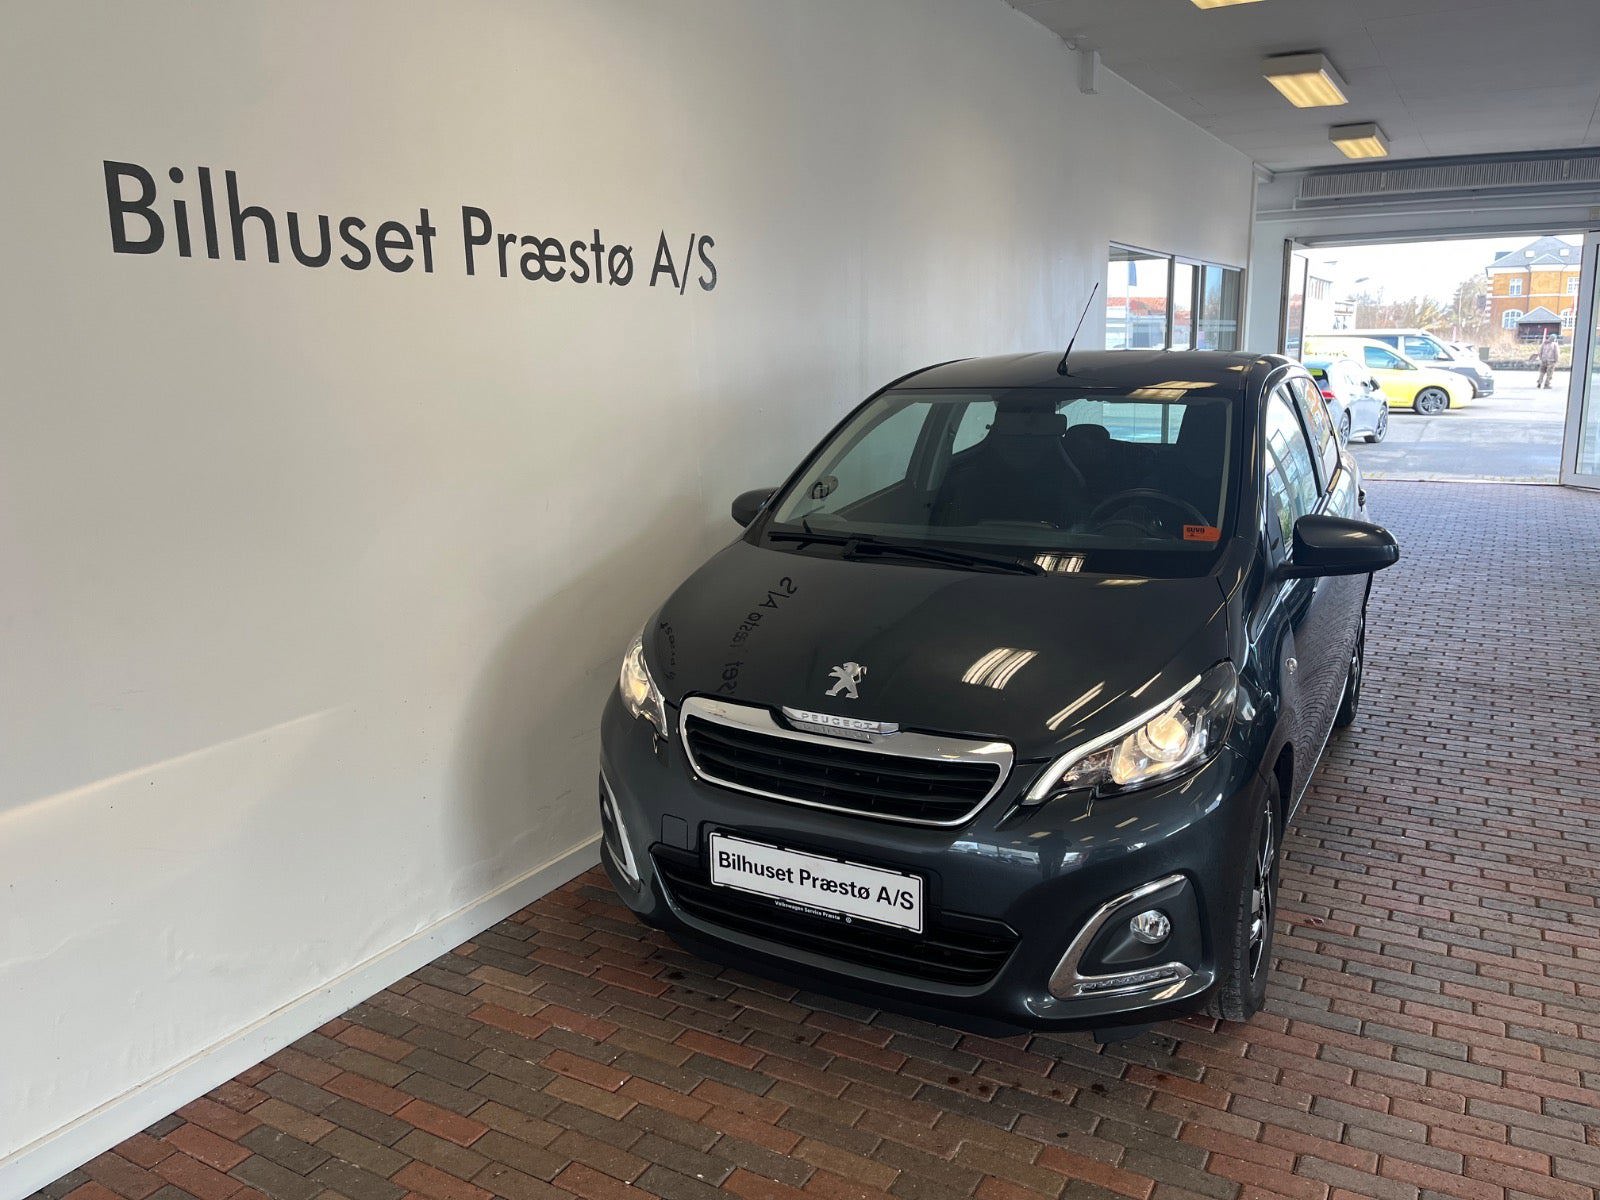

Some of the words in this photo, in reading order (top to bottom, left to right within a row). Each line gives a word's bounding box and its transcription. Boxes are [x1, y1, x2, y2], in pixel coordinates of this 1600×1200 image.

[103, 160, 437, 273] Bilhuset
[462, 205, 634, 287] Præstø
[650, 229, 717, 296] A/S
[801, 712, 873, 729] PEUGEOT
[718, 851, 794, 884] Bilhuset
[799, 868, 870, 900] Præstø
[876, 886, 914, 911] A/S
[804, 907, 822, 916] Service
